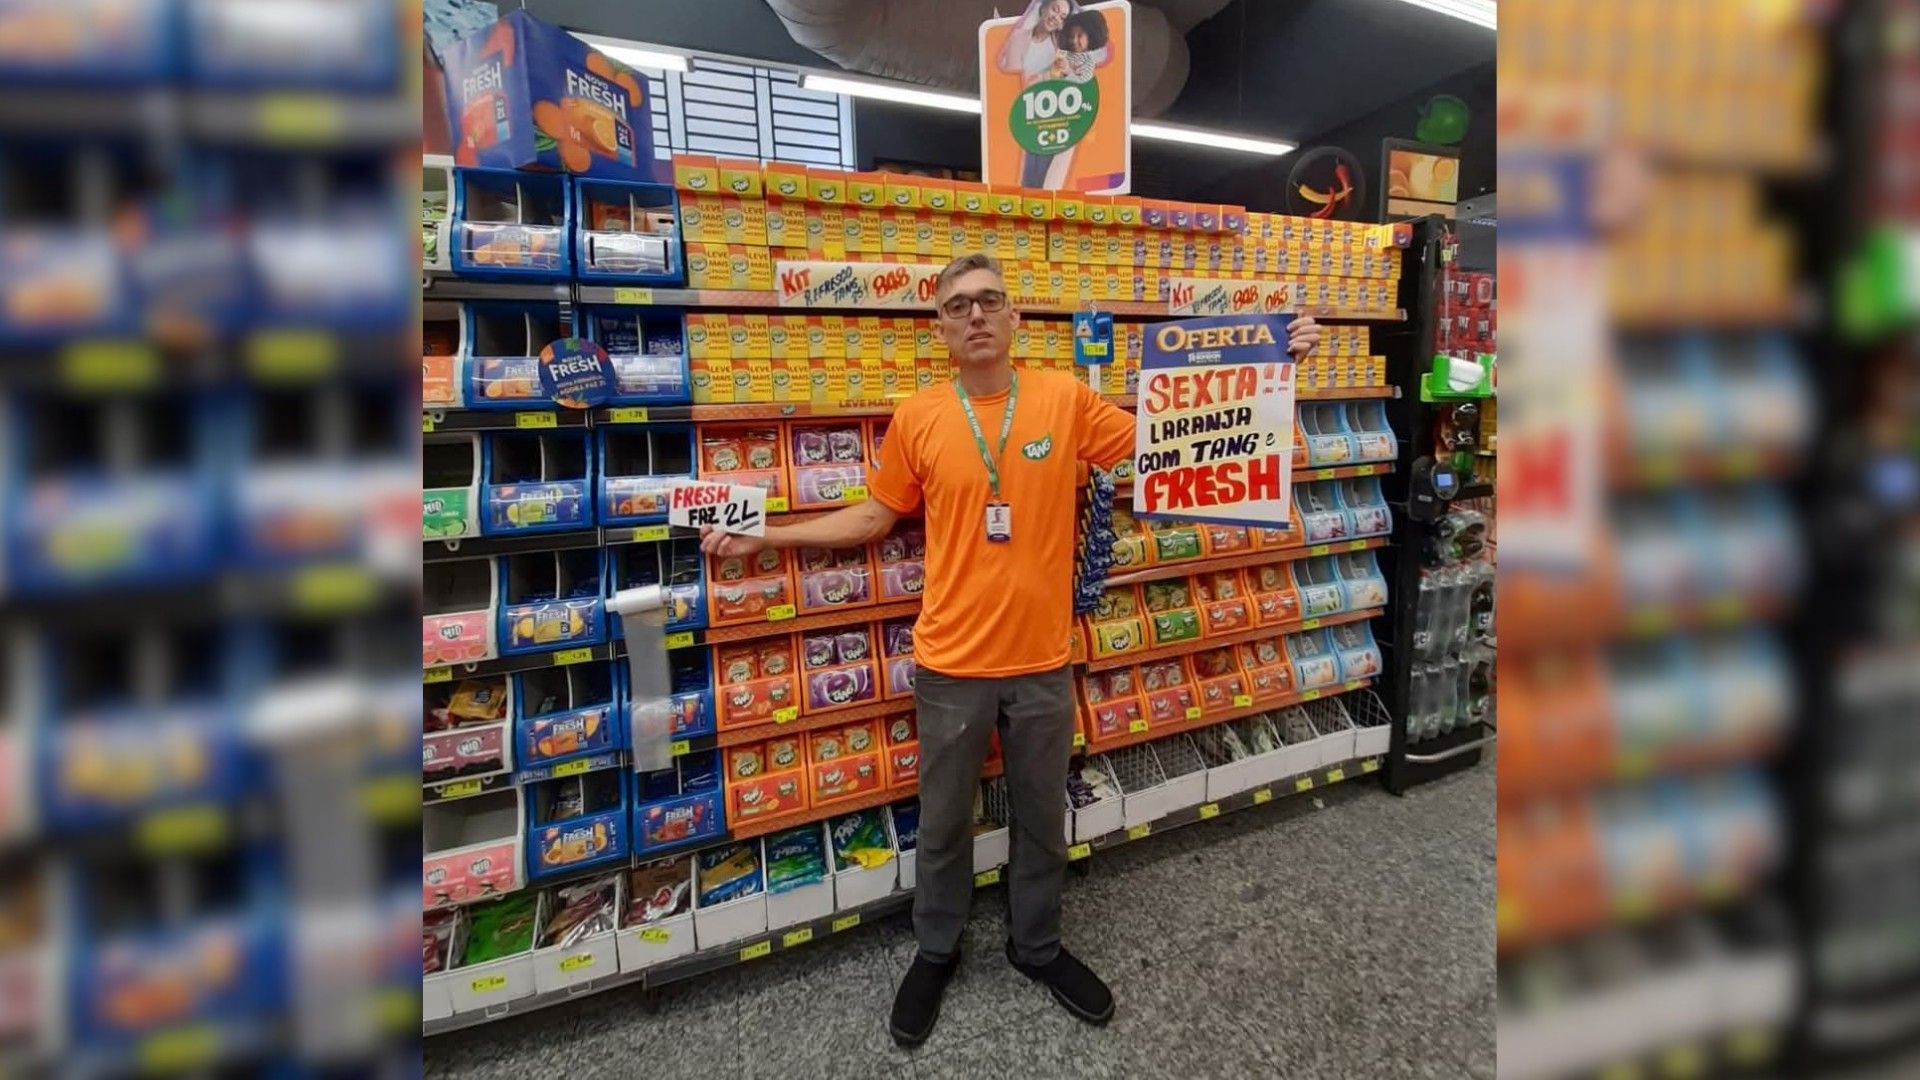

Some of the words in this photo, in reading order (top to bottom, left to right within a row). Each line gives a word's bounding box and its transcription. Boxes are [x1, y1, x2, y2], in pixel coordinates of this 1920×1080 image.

[463, 61, 502, 102] FRESH
[567, 69, 627, 120] FRESH
[1023, 86, 1091, 120] 100%
[781, 268, 811, 297] KIT
[1172, 282, 1194, 307] KIT
[1156, 324, 1276, 352] OFERTA
[549, 354, 602, 381] FRESH
[839, 399, 867, 408] LEVE
[868, 399, 894, 407] MAIS
[1150, 407, 1251, 444] LARANJA
[1024, 438, 1052, 458] TANG
[1138, 449, 1181, 474] COM
[1191, 433, 1260, 463] TANG
[1144, 454, 1281, 513] FRESH
[673, 486, 731, 509] FRESH
[688, 506, 719, 526] FAZ
[724, 499, 759, 527] 2L
[827, 585, 849, 601] TANG
[833, 686, 854, 702] TANG
[552, 718, 584, 734] FRESH
[665, 806, 694, 823] FRESH
[563, 825, 594, 843] FRESH
